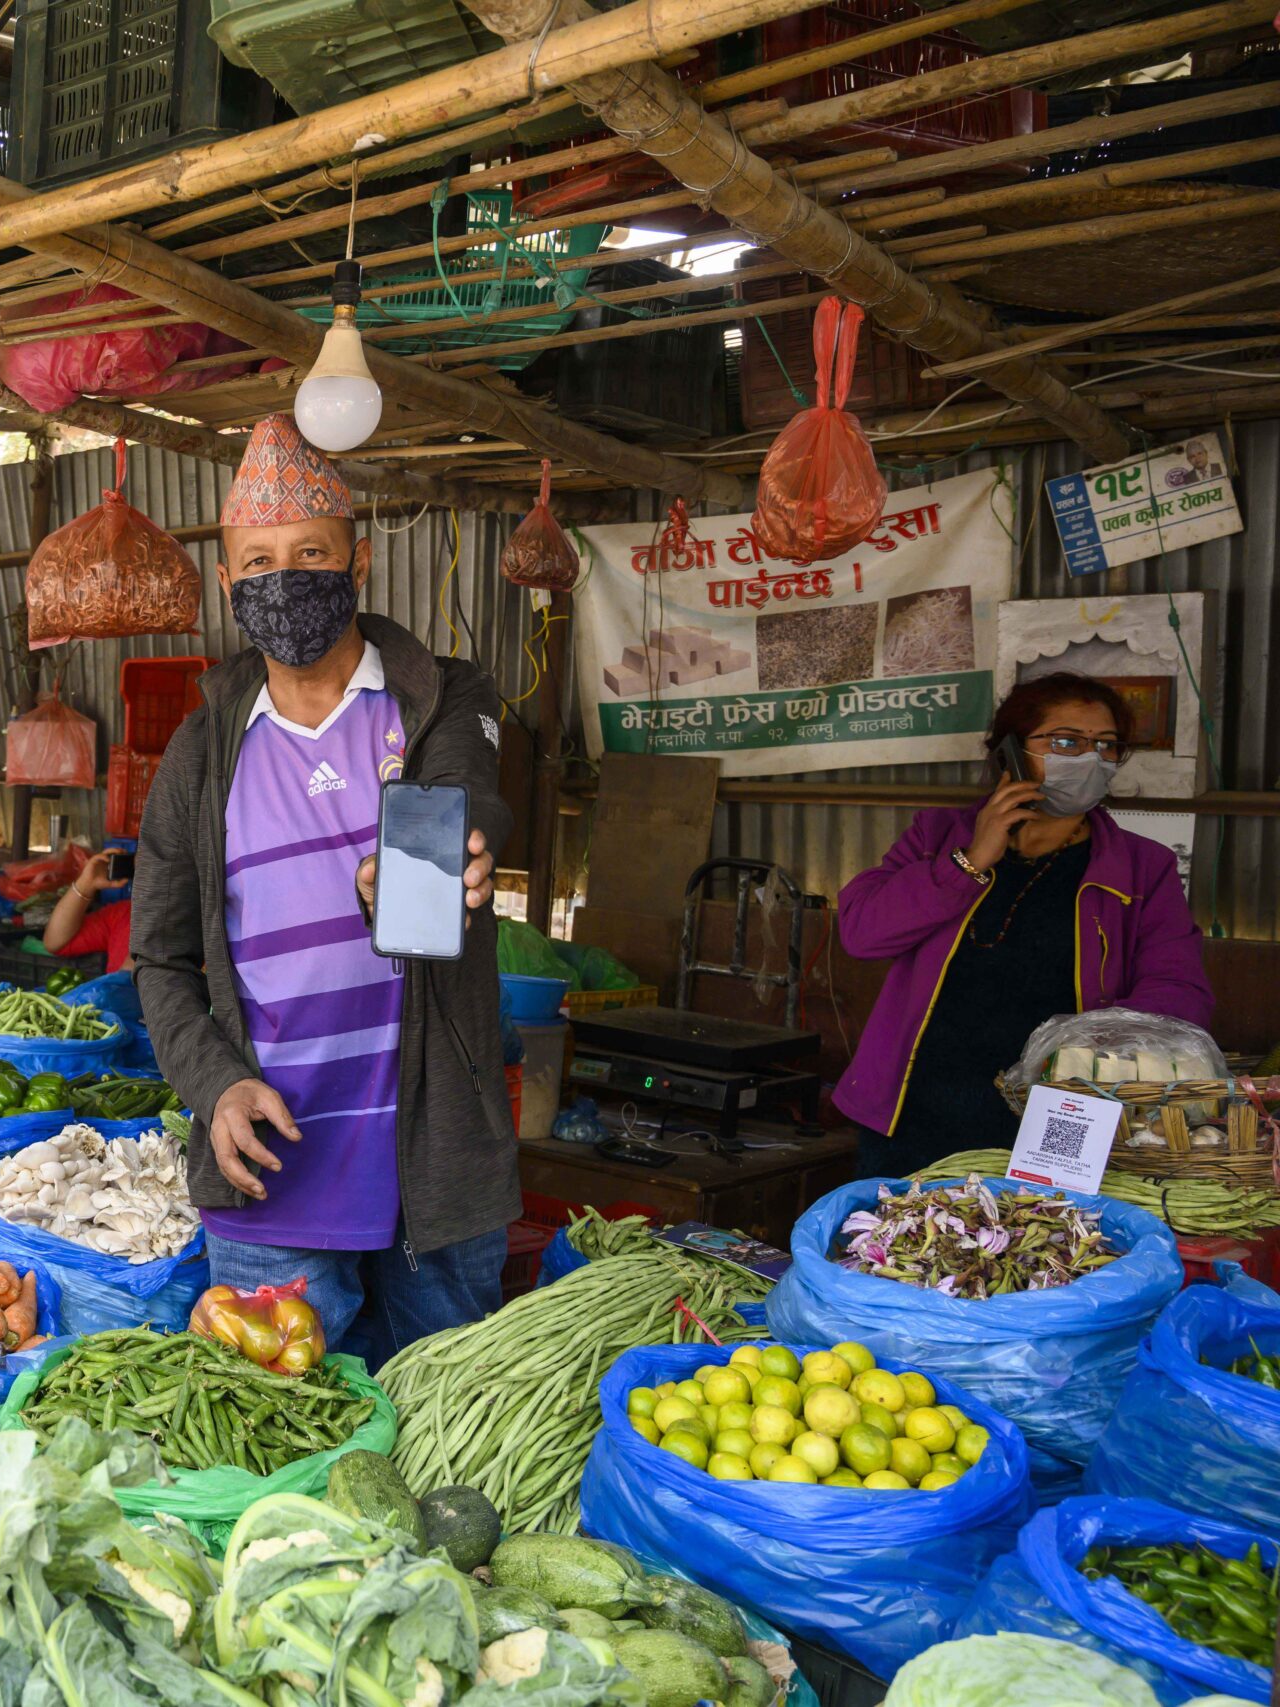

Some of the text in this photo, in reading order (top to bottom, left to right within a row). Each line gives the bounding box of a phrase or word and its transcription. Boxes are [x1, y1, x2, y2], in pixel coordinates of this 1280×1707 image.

[1094, 466, 1144, 502] १९
[1101, 513, 1131, 532] पवन
[706, 566, 834, 610] पाईन्छ
[620, 683, 961, 731] भेराइटी फ्रेस एग्रो प्रोडक्ट्स
[307, 777, 348, 797] adidas
